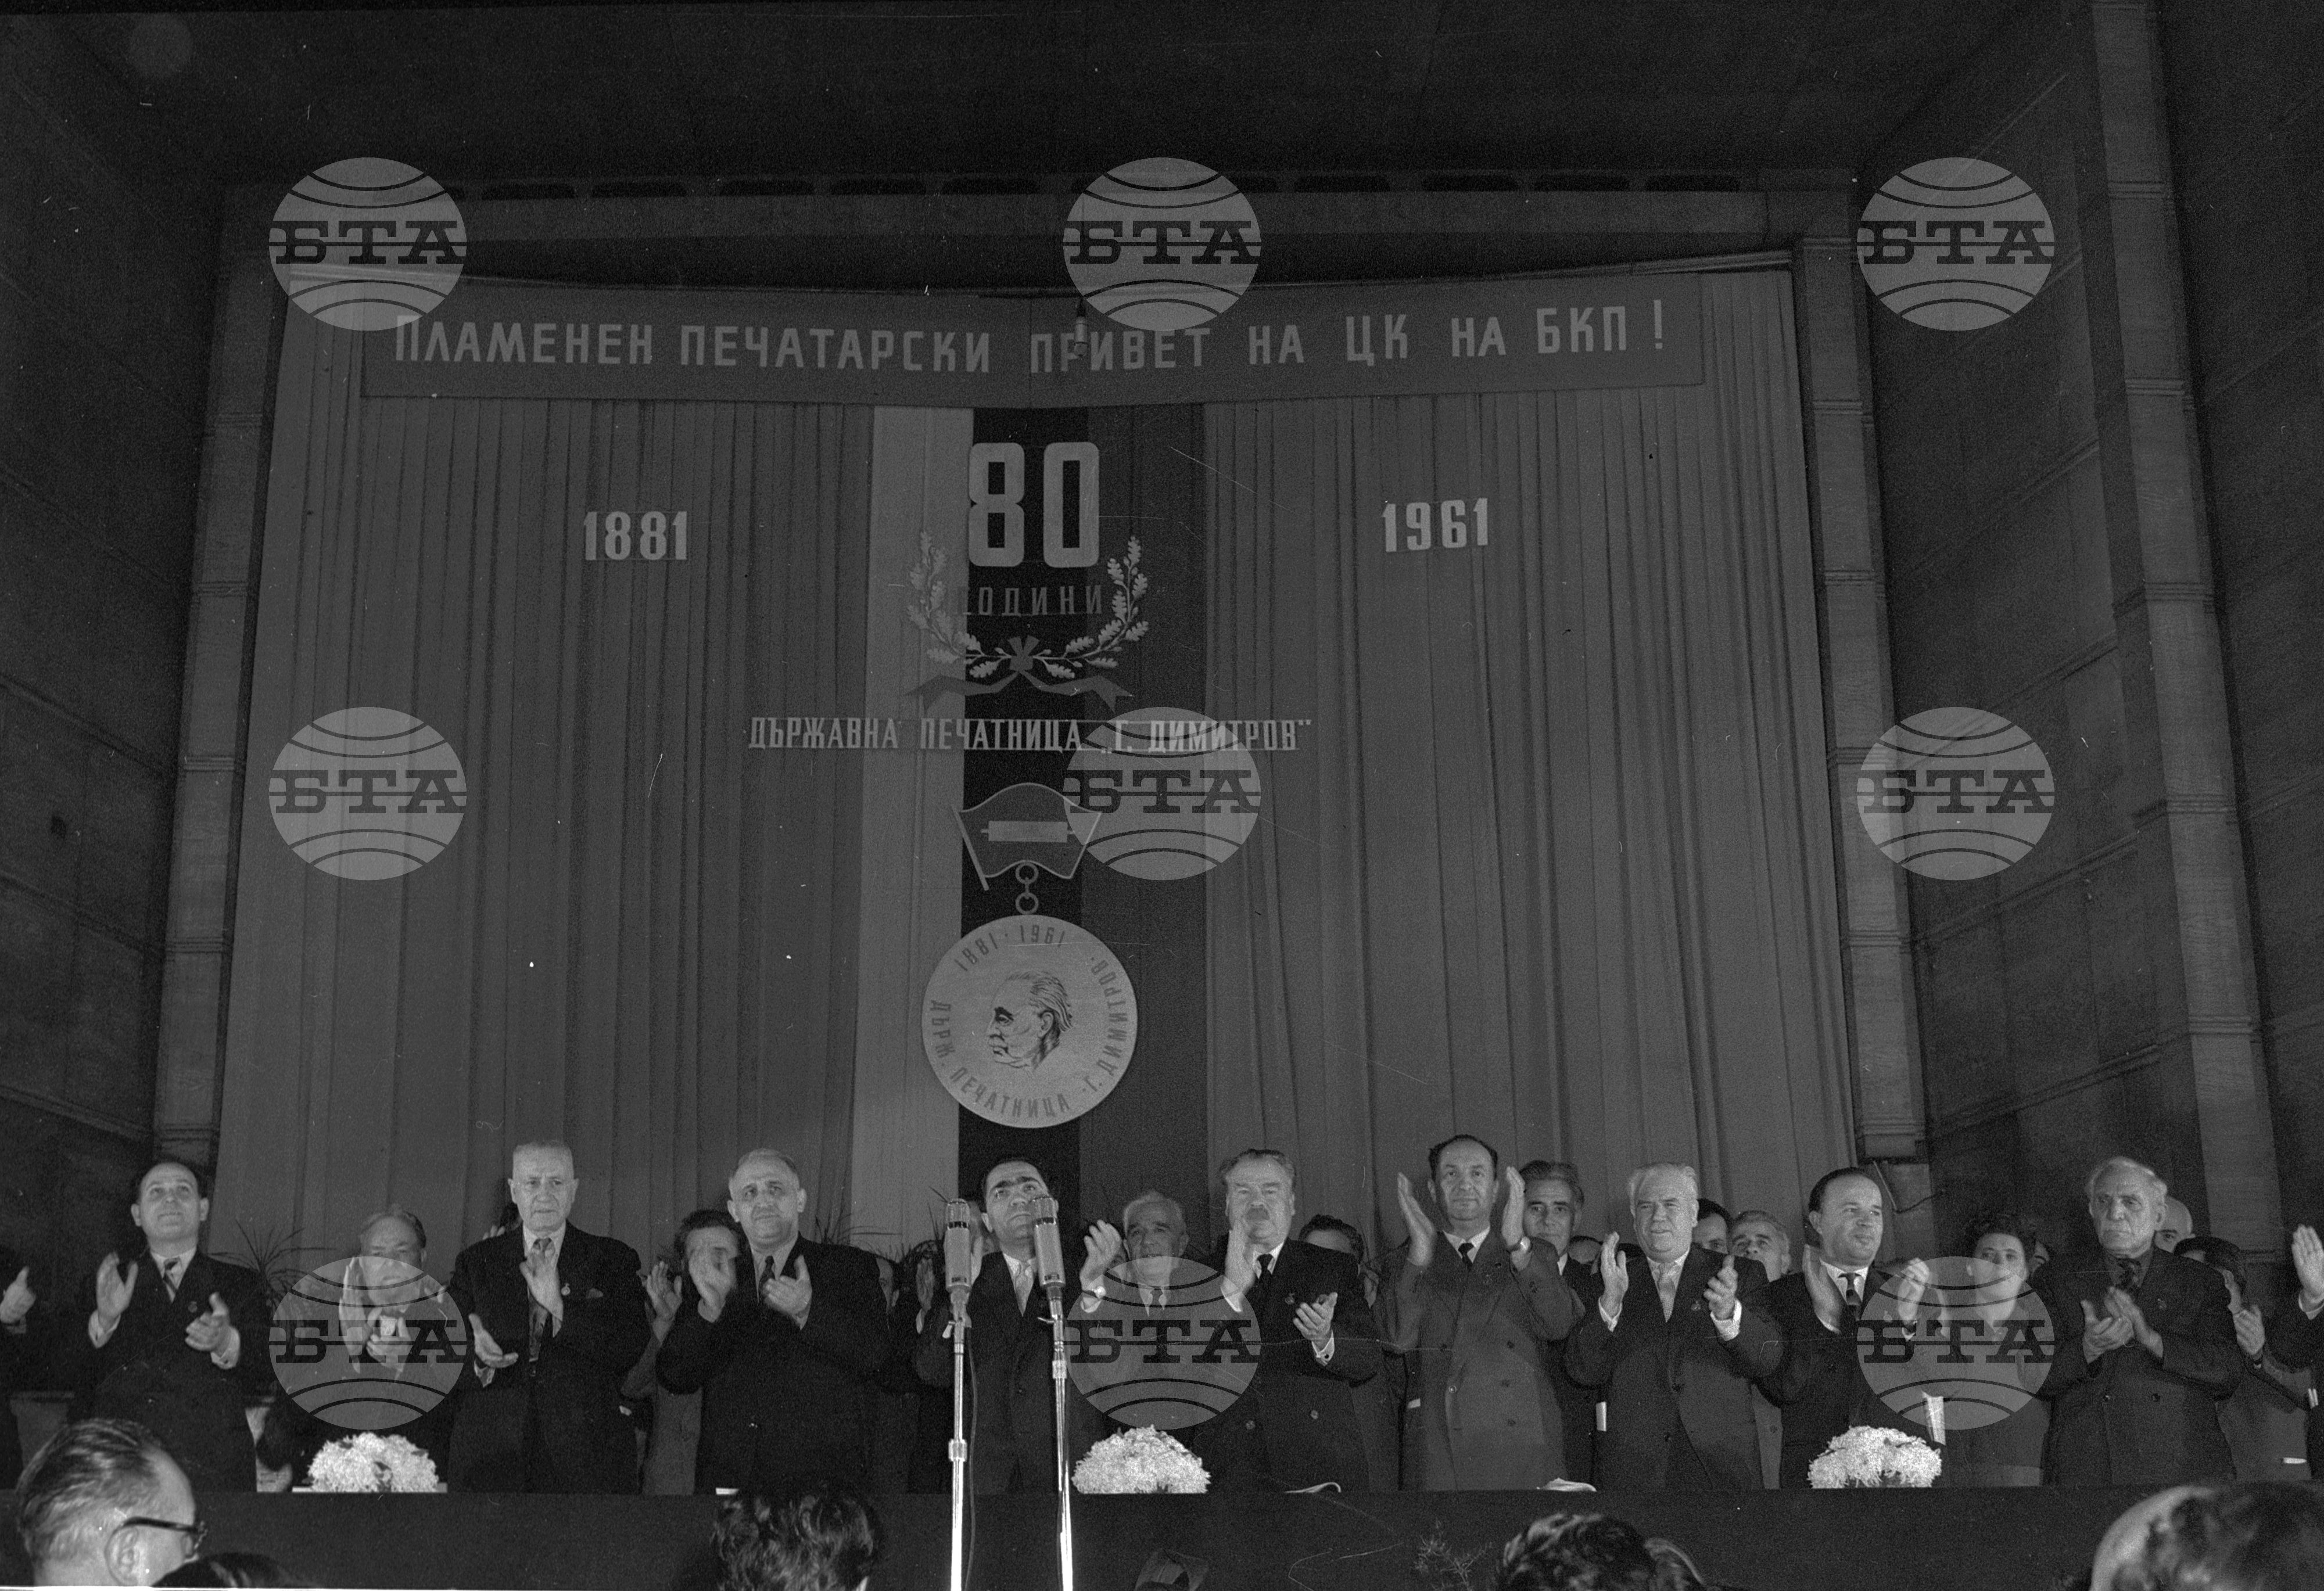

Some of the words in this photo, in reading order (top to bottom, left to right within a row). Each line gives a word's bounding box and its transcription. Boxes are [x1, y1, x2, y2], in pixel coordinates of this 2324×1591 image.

[395, 315, 652, 365] ПЛАМЕНЕН
[680, 324, 989, 373] ПЕЧАТАРСКИ
[1030, 328, 1211, 373] ПРИВЕТ
[1249, 324, 1304, 365] НА
[1346, 314, 1408, 367] ЦК
[1451, 316, 1507, 358] НА
[969, 441, 1099, 568] 80
[1381, 497, 1489, 552] 1961
[583, 511, 687, 561] 1881
[748, 716, 899, 750] ДЪРЖАВНА
[920, 719, 1083, 753] ПЕЧАТНИЦА
